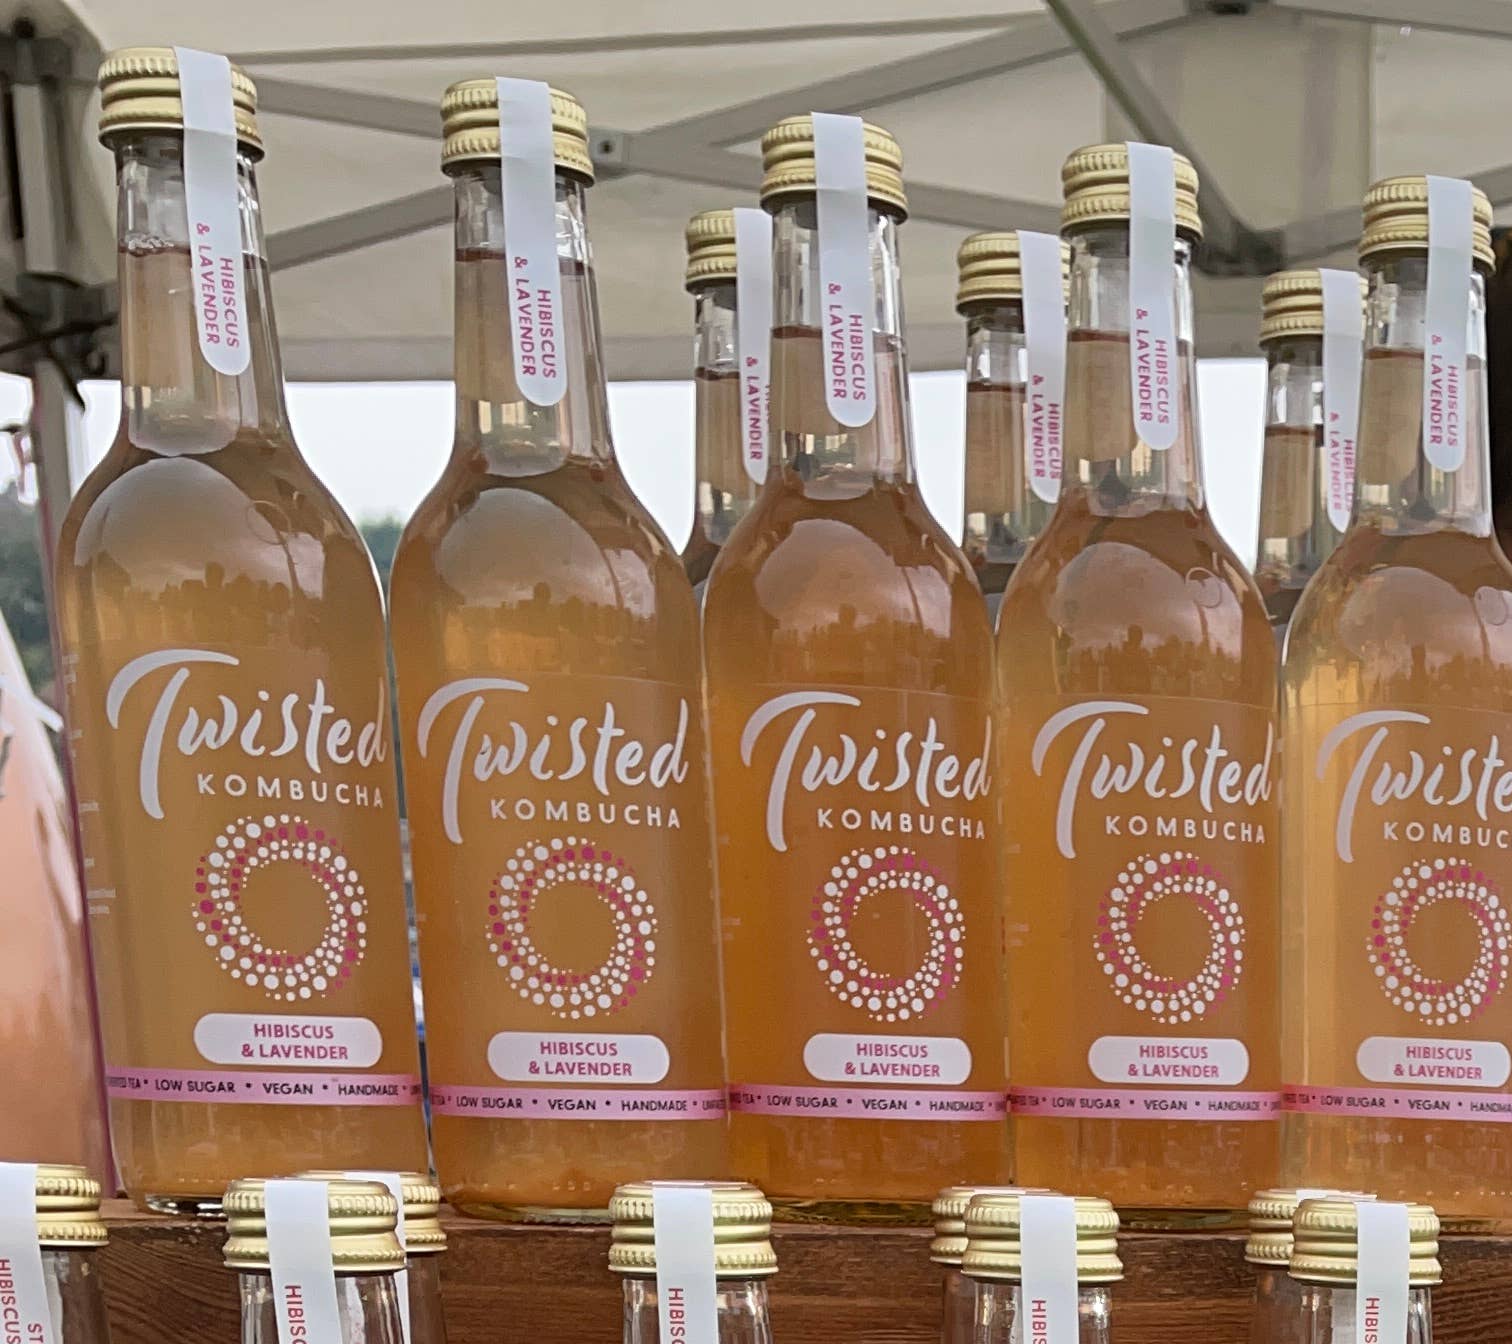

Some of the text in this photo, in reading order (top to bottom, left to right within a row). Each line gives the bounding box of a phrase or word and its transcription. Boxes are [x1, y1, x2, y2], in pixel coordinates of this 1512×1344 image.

[196, 223, 220, 345] & LAVENDER
[219, 257, 240, 348] HIBISCUS
[514, 256, 537, 377] & LAVENDER
[537, 289, 557, 379] HIBISCUS
[827, 282, 848, 400] & LAVENDER
[849, 314, 867, 401] HIBISCUS
[1135, 309, 1152, 423] & LAVENDER
[1155, 339, 1170, 425] HIBISCUS
[1430, 334, 1444, 446] & LAVENDER
[1446, 365, 1459, 448] HIBISCUS
[106, 649, 388, 819] Twisted
[418, 678, 688, 844] Twisted
[740, 691, 991, 852] Twisted
[197, 773, 384, 809] KOMBUCHA
[490, 799, 681, 829] KOMBUCHA
[1032, 701, 1274, 859] Twisted
[817, 808, 986, 840] KOMBUCHA
[1105, 816, 1266, 844] KOMBUCHA
[241, 1043, 349, 1060] & LAVENDER
[254, 1023, 334, 1040] HIBISCUS
[844, 1063, 940, 1078] & LAVENDER
[856, 1043, 928, 1059] HIBISCUS
[1393, 1064, 1482, 1080] & LAVENDER
[1405, 1046, 1473, 1061] HIBISCUS
[155, 1078, 400, 1097] LOW SUGAR VEGAN HANDMADE
